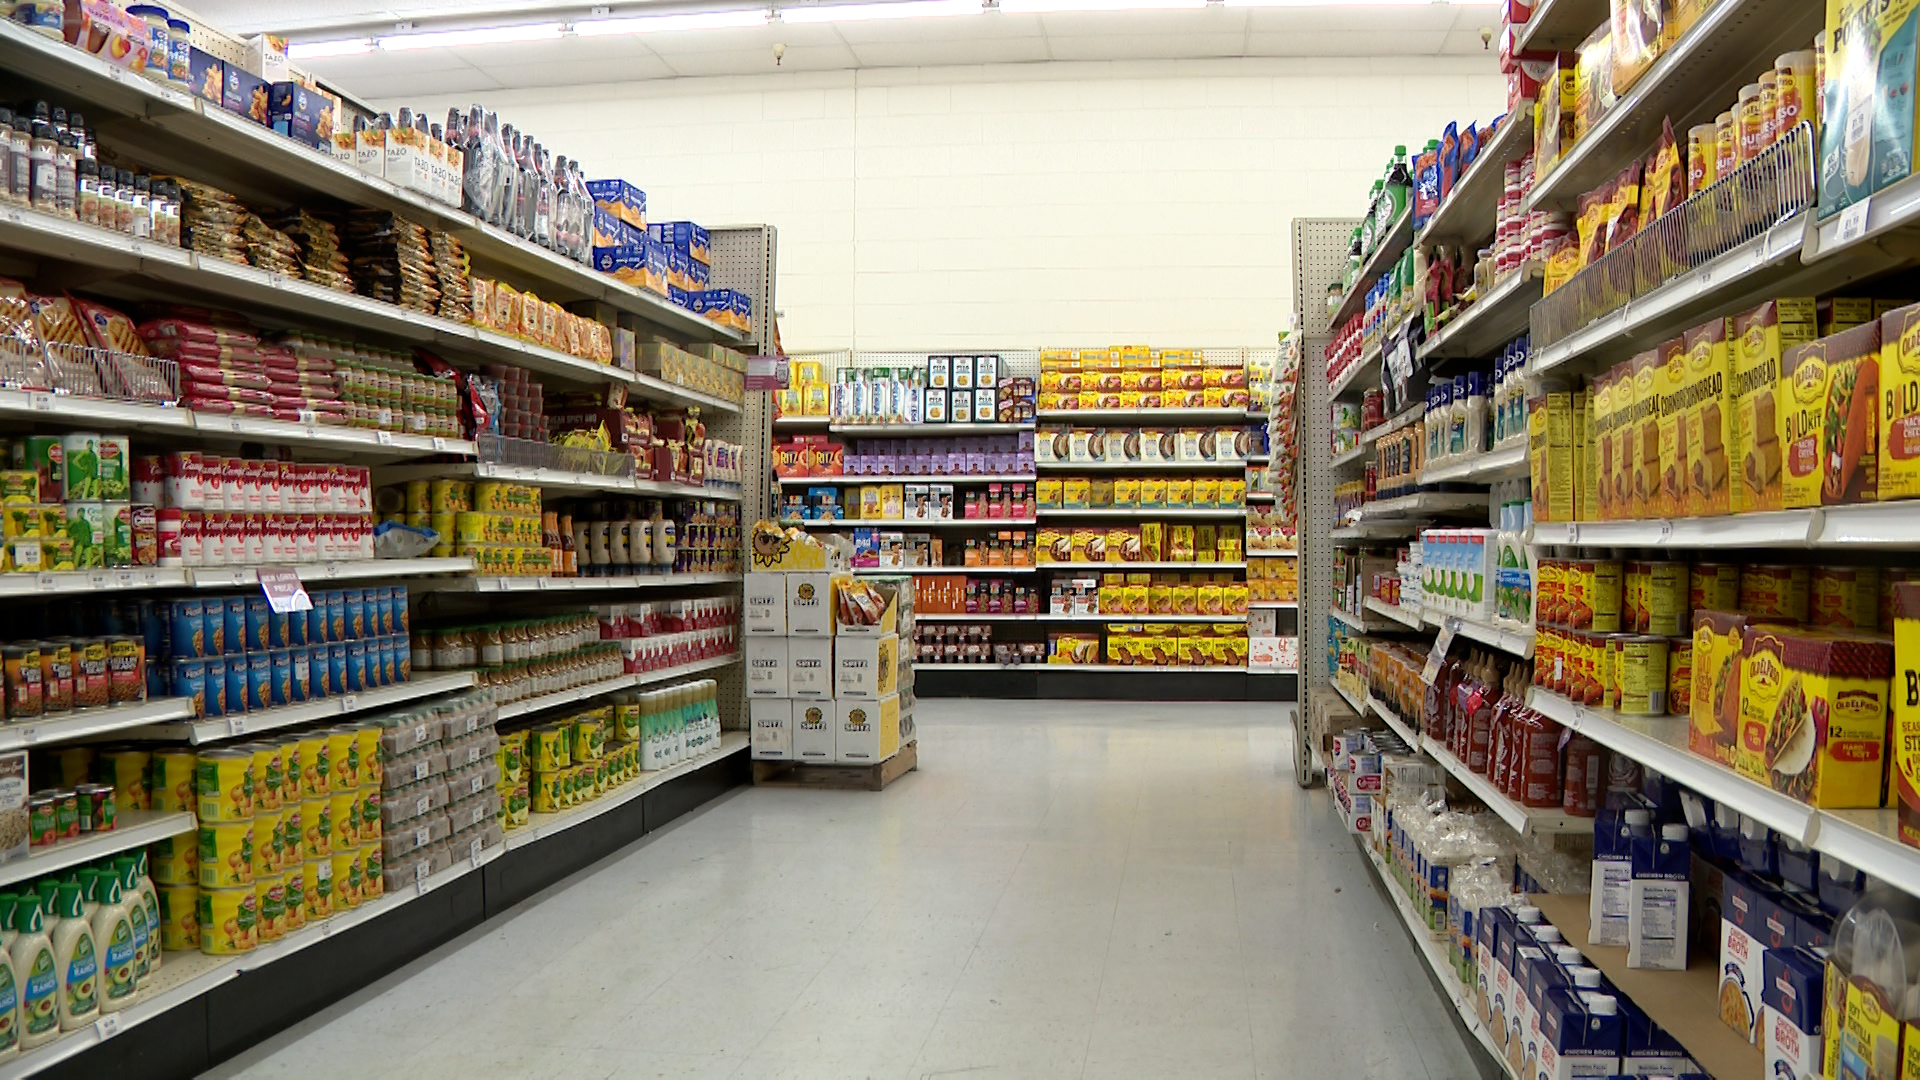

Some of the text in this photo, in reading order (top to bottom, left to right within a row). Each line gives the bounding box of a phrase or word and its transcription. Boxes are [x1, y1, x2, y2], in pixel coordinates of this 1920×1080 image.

[264, 53, 284, 62] TAZO
[358, 149, 378, 157] TAZO
[387, 148, 407, 156] TAZO
[1736, 357, 1777, 398] CORNBREAD
[1808, 413, 1821, 430] KIT
[781, 451, 798, 464] RITZ
[816, 451, 834, 464] RITZ
[843, 660, 868, 668] SPITZ
[1836, 701, 1850, 710] OLD
[1861, 700, 1879, 712] PASO
[1829, 725, 1843, 738] 12
[1728, 936, 1748, 959] BROTH
[1775, 1025, 1800, 1059] BROTH
